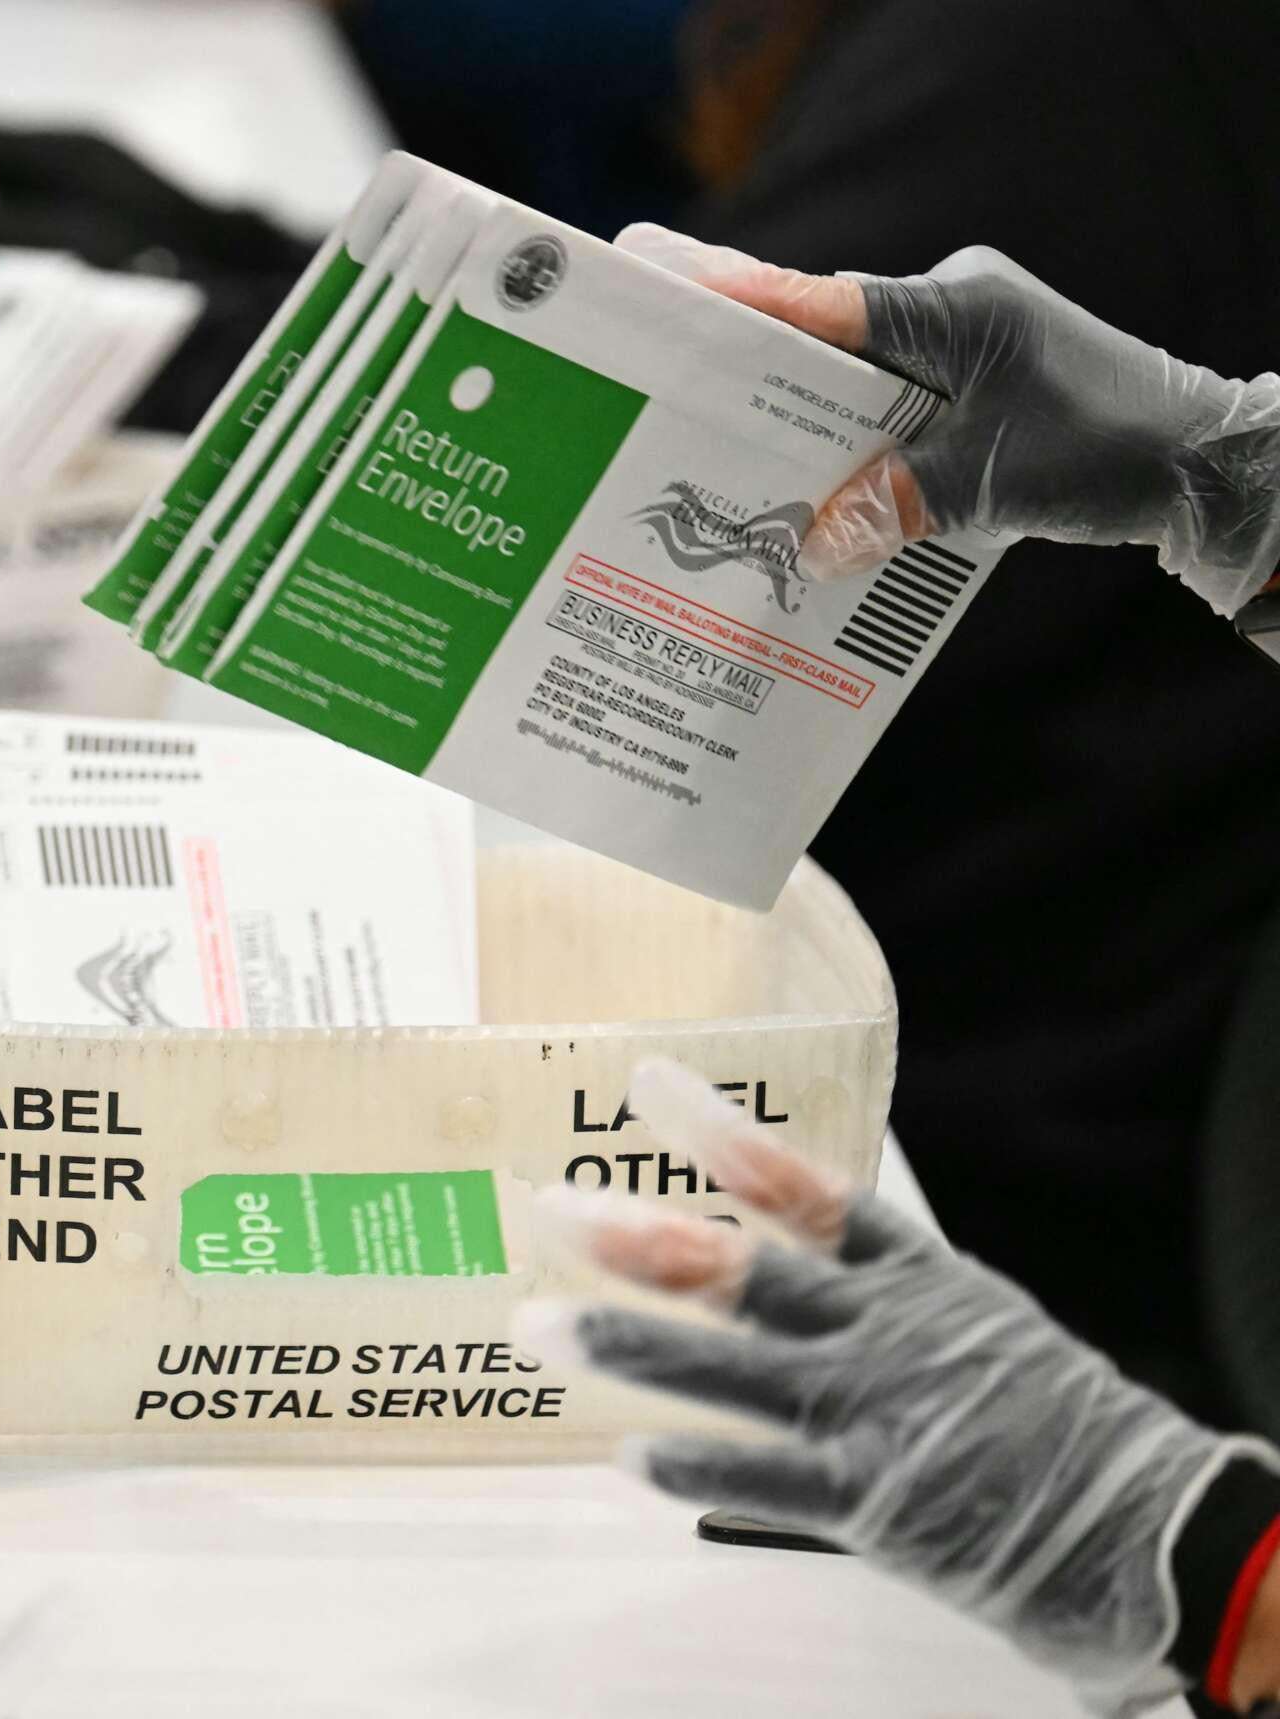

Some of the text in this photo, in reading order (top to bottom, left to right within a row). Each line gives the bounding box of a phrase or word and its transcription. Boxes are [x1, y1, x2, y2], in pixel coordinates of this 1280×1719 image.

[749, 393, 767, 410] 30
[768, 403, 792, 421] MAY
[765, 372, 787, 389] LOS
[788, 383, 838, 413] ANGELES
[839, 406, 854, 420] CA
[382, 409, 509, 497] Return
[357, 450, 526, 557] Envelope
[679, 480, 750, 520] OFFICIAL
[671, 498, 752, 551] ELECTION
[560, 594, 765, 697] BUSINESS REPLY MAIL
[550, 654, 686, 722] COUNTY OF LOS ANGELES
[838, 679, 862, 697] MAIL
[526, 696, 551, 715] CITY
[552, 707, 569, 722] OF
[568, 715, 624, 747] INDUSTRY
[623, 739, 640, 754] CA
[705, 739, 739, 761] CLERK
[157, 1344, 340, 1375] UNITED
[135, 1387, 567, 1420] POSTAL SERVICE
